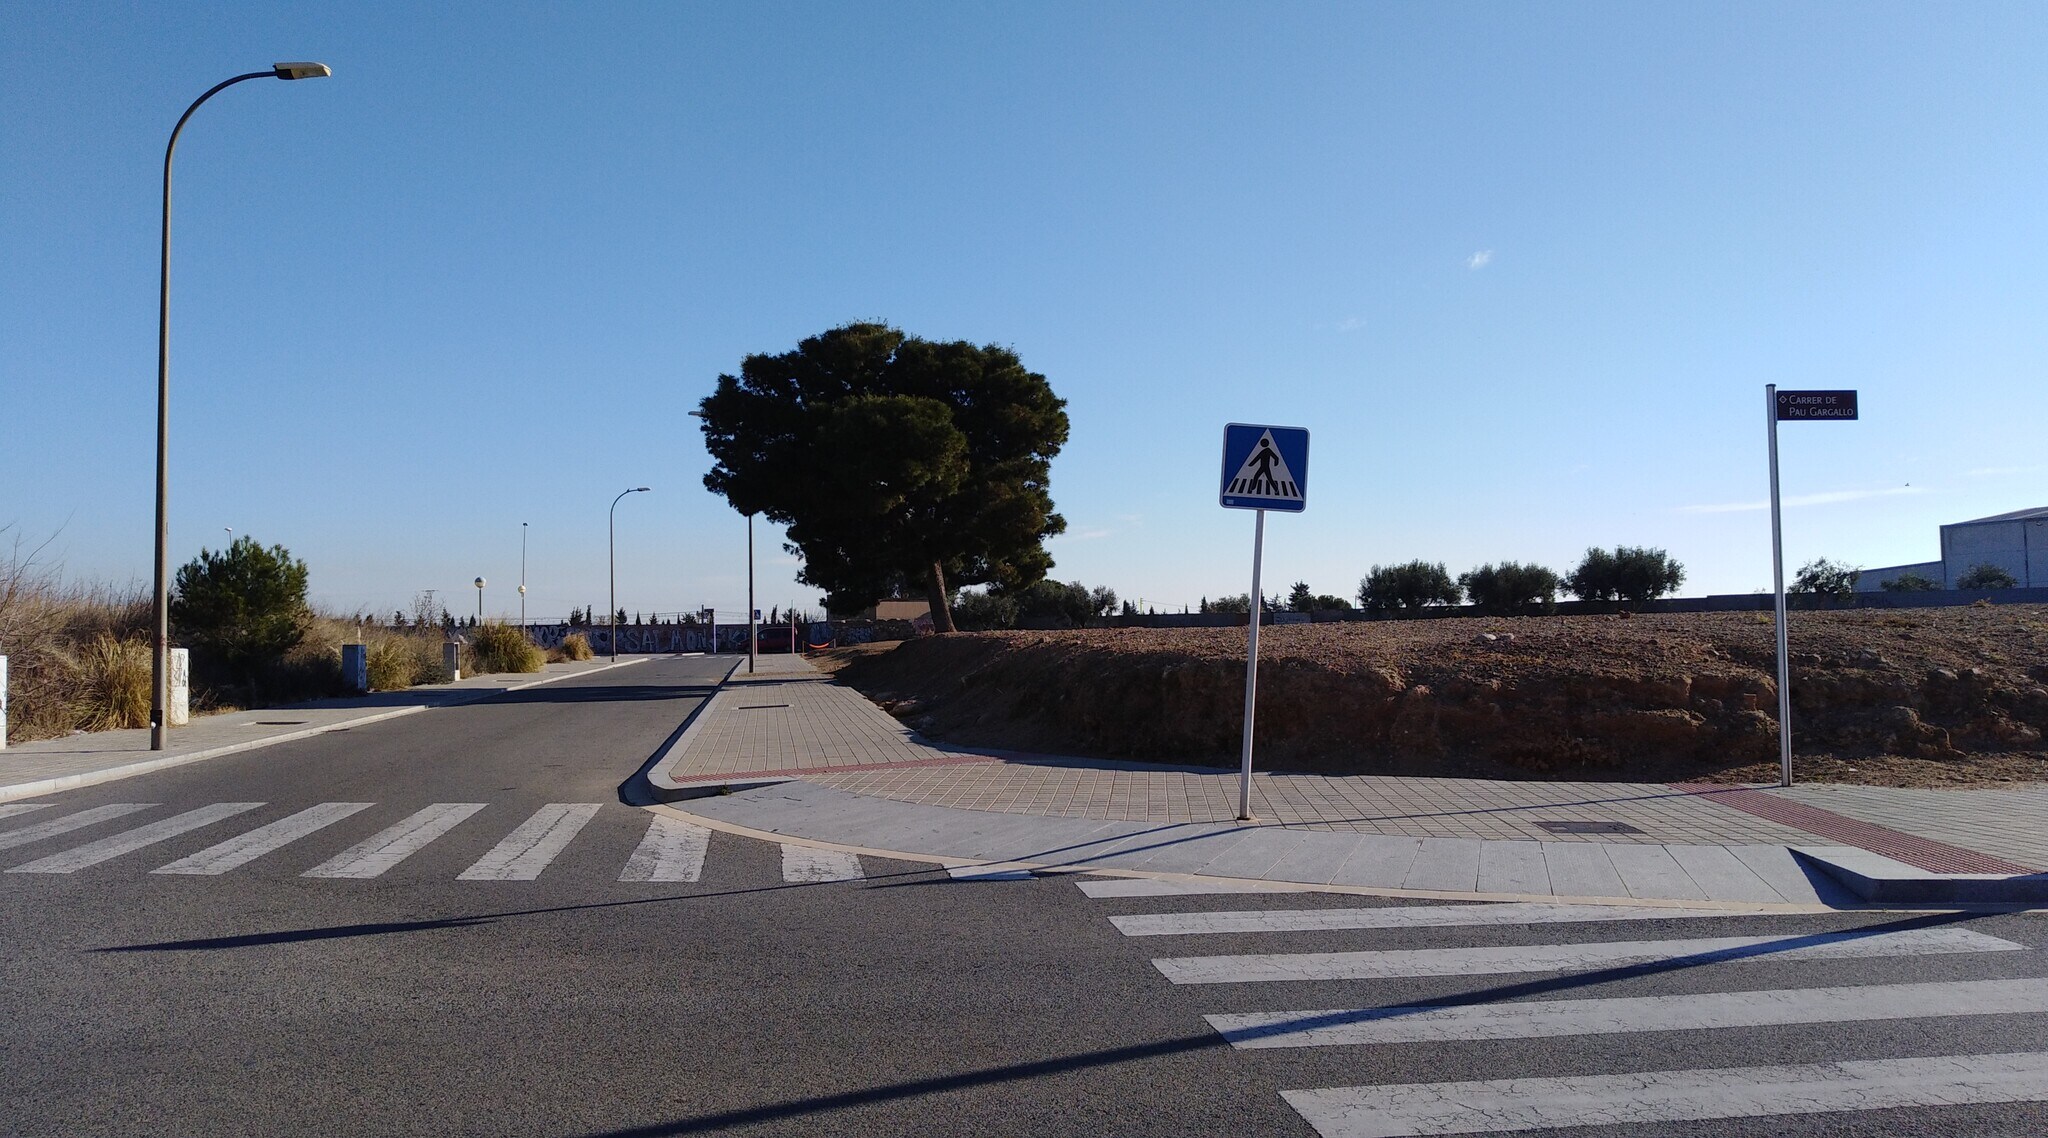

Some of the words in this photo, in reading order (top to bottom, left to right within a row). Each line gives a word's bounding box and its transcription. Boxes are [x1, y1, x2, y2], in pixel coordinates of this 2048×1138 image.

[1789, 395, 1823, 404] CARRER
[1825, 396, 1837, 404] DE
[1789, 407, 1806, 416] PAU
[1809, 407, 1853, 416] GARGALLO
